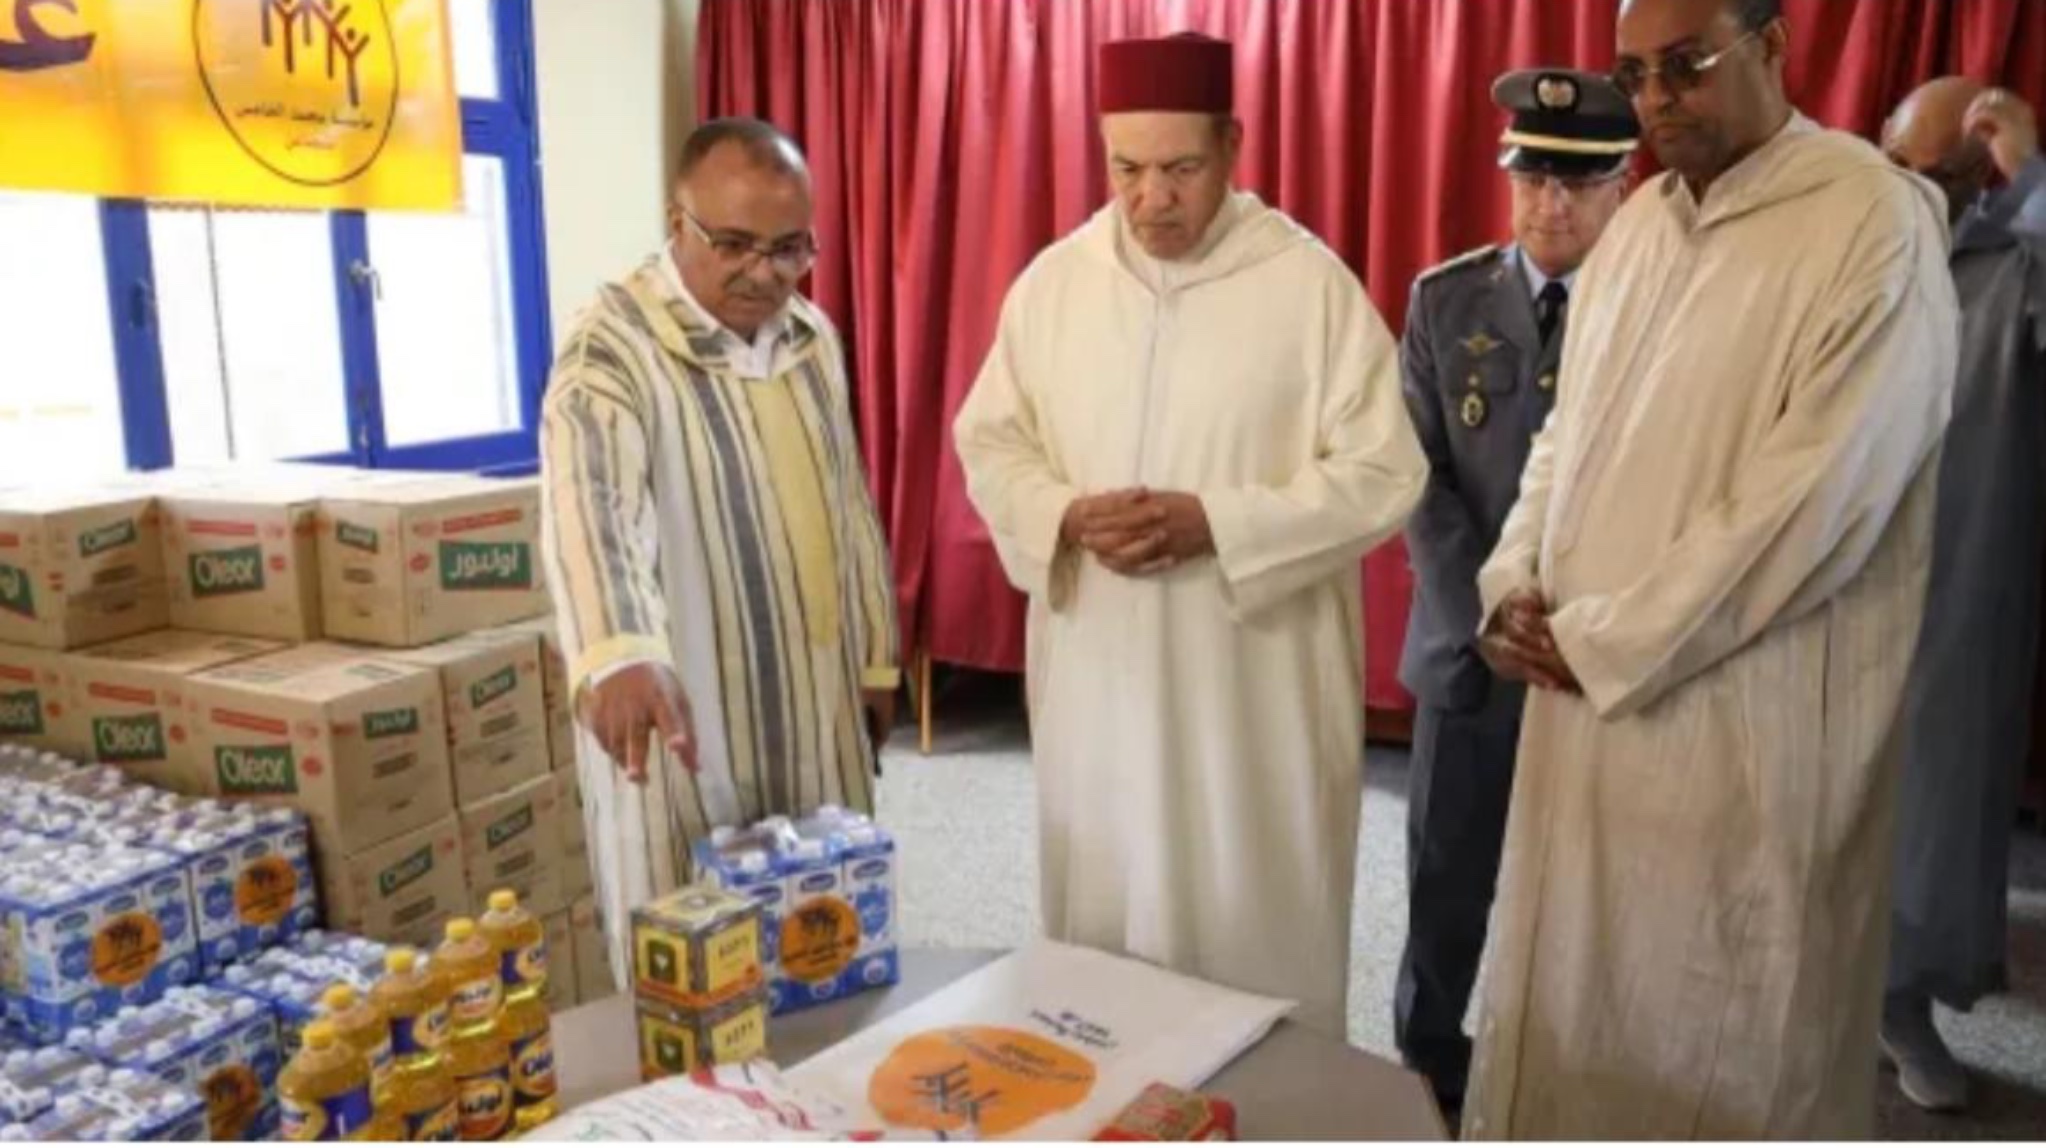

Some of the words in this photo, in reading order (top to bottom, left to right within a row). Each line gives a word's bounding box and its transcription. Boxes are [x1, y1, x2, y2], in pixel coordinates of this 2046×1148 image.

[194, 554, 257, 590] Oleor
[99, 721, 157, 751] Oleor
[220, 750, 287, 785] Oleor
